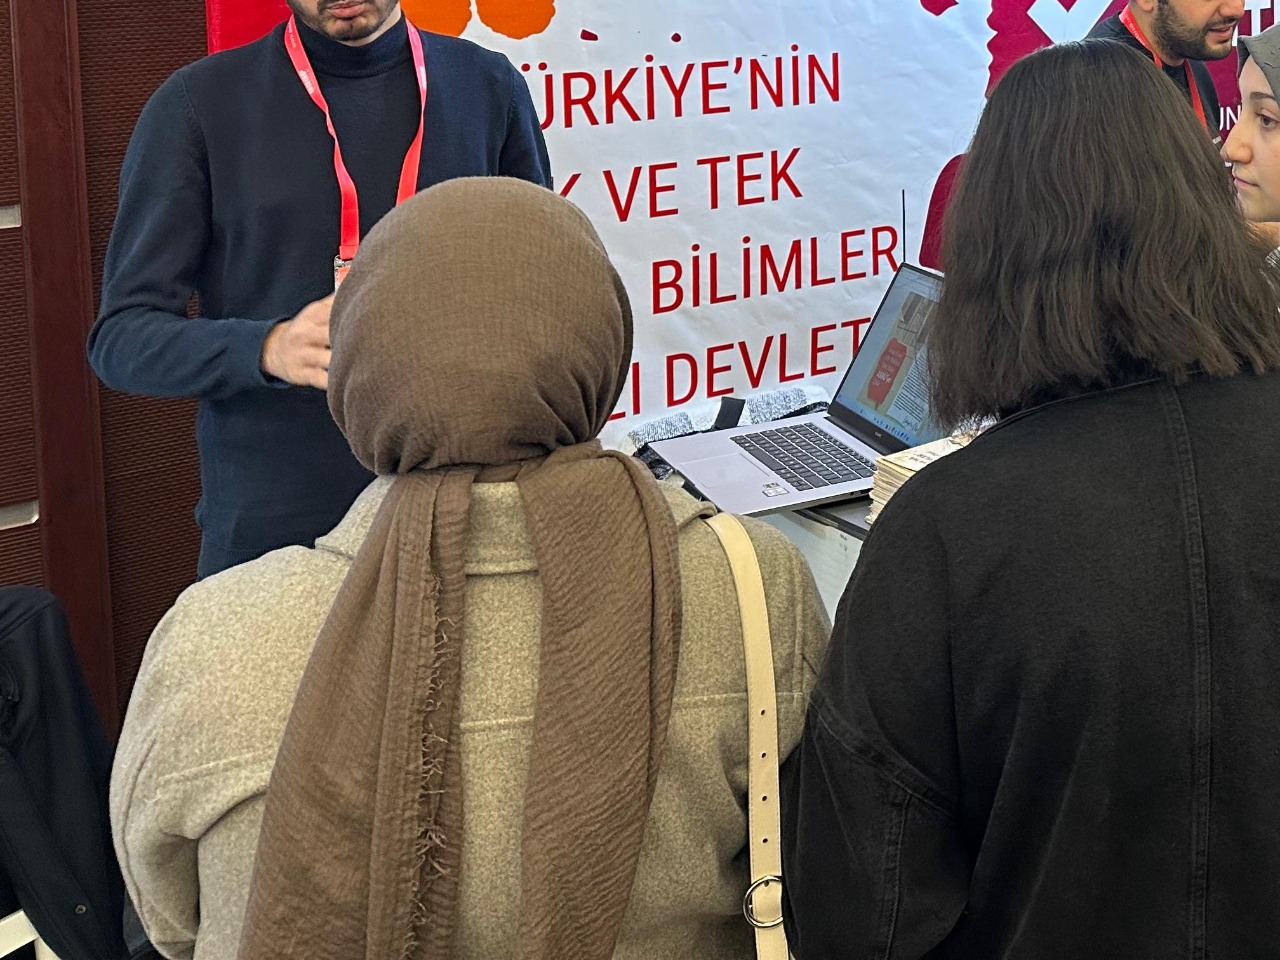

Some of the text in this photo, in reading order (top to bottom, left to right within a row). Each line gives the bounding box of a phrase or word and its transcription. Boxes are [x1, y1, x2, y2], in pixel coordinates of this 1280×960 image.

[602, 161, 679, 223] VE
[696, 147, 803, 210] TEK
[651, 235, 899, 315] BİLİMLER
